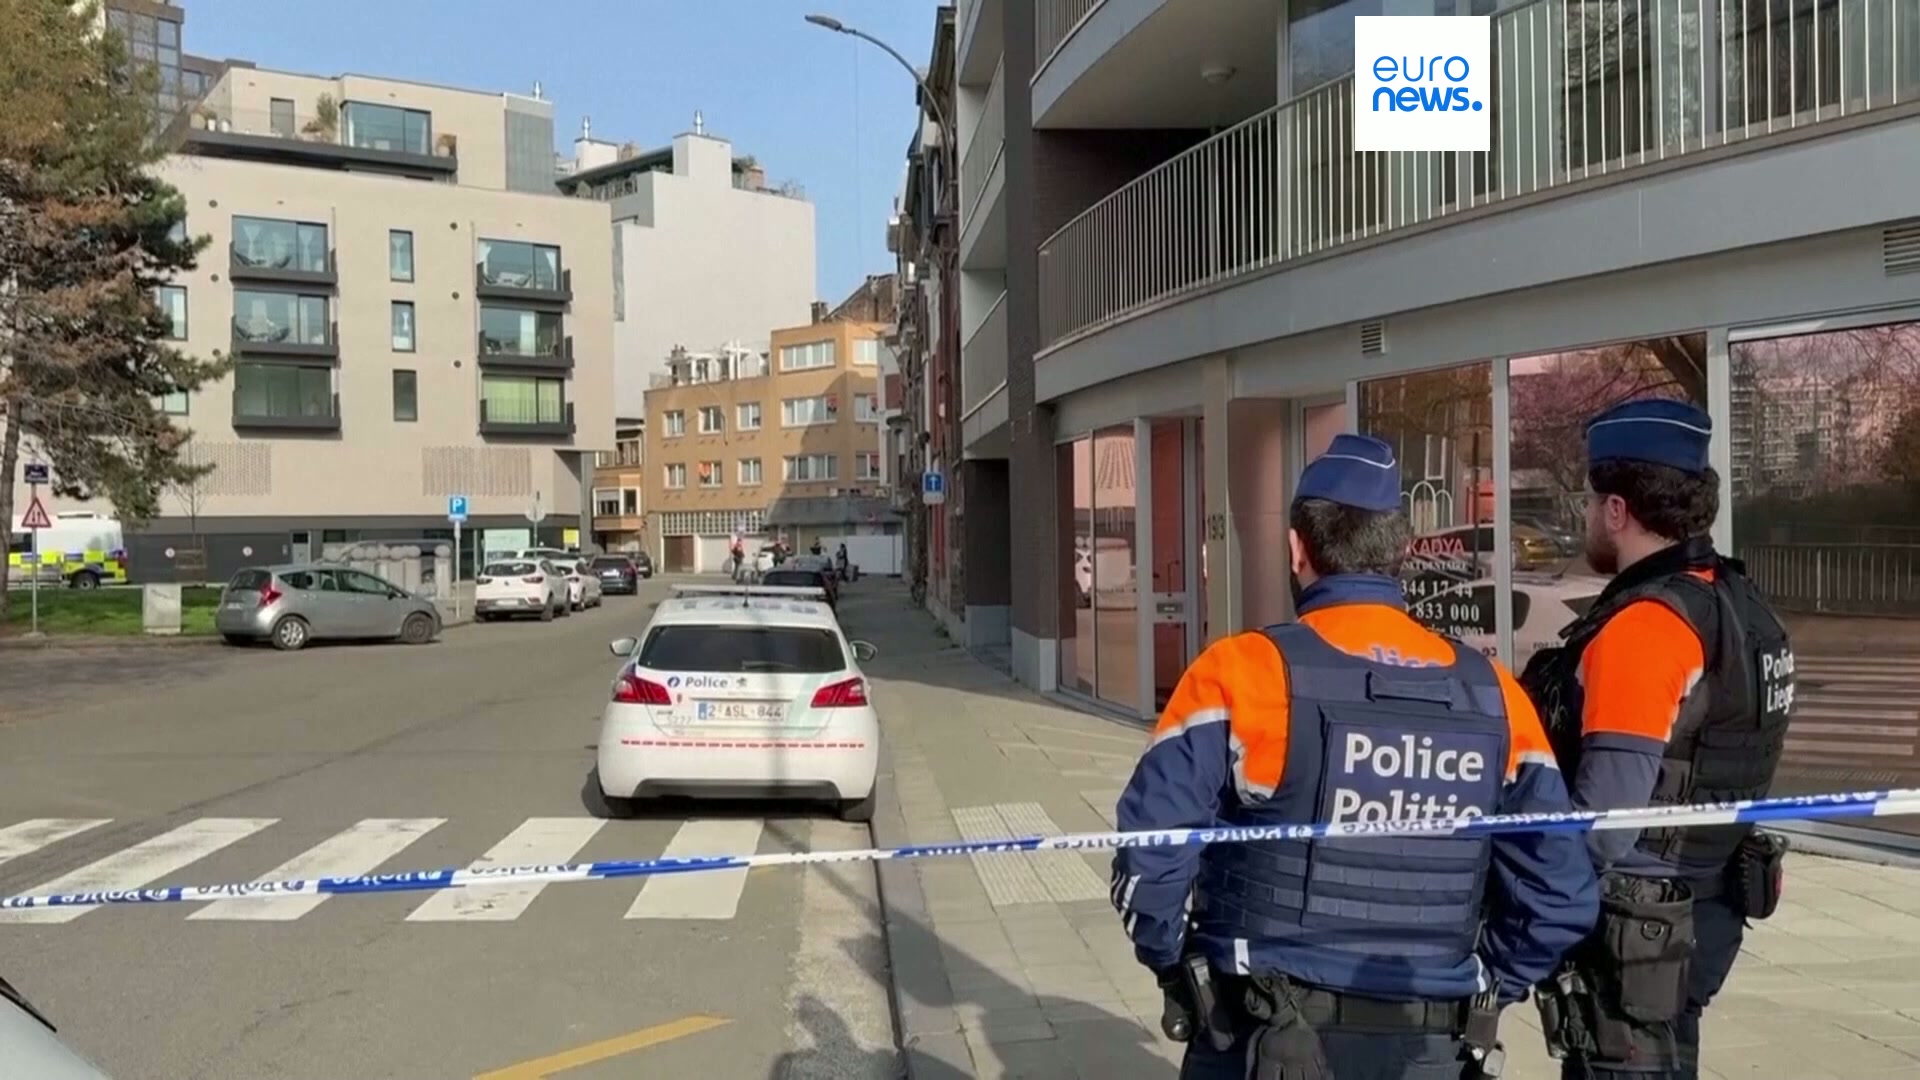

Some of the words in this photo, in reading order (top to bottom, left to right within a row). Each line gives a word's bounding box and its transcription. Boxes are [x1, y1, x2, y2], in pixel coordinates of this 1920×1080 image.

[453, 499, 462, 512] P
[1416, 603, 1444, 620] 833
[1451, 604, 1480, 621] 000
[685, 676, 728, 688] Police
[1344, 732, 1485, 782] Police
